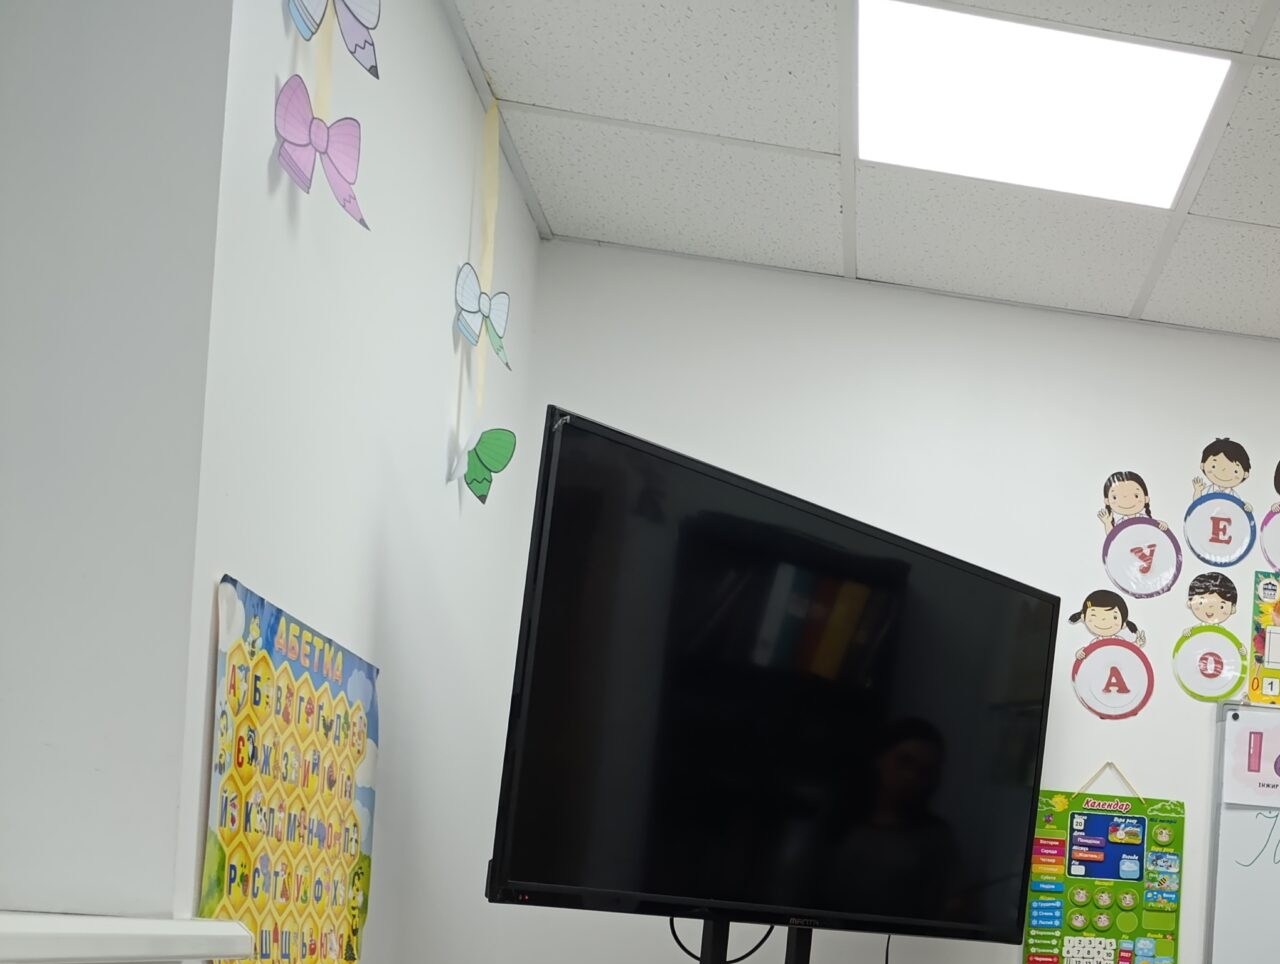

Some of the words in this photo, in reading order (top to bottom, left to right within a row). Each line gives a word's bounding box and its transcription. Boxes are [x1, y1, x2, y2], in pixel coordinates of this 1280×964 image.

[1209, 516, 1233, 544] Е
[1129, 543, 1157, 574] У
[274, 616, 344, 685] АБЕТКА
[1198, 651, 1224, 679] О
[1102, 666, 1130, 694] А
[1251, 676, 1260, 692] 0
[1266, 681, 1274, 692] 1
[229, 664, 237, 698] А
[253, 674, 262, 707] Б
[275, 685, 283, 715] В
[334, 713, 341, 746] Д
[261, 744, 272, 776] Ж
[1258, 782, 1280, 790] ІНЖИР
[1083, 798, 1132, 812] Календар
[244, 800, 253, 833] К
[286, 812, 298, 842] М
[307, 817, 315, 846] Н
[228, 864, 238, 896] Р
[252, 867, 260, 898] С
[273, 870, 280, 900] Т
[314, 876, 324, 904] Ф
[331, 879, 340, 906] Х
[260, 929, 271, 960] Ш
